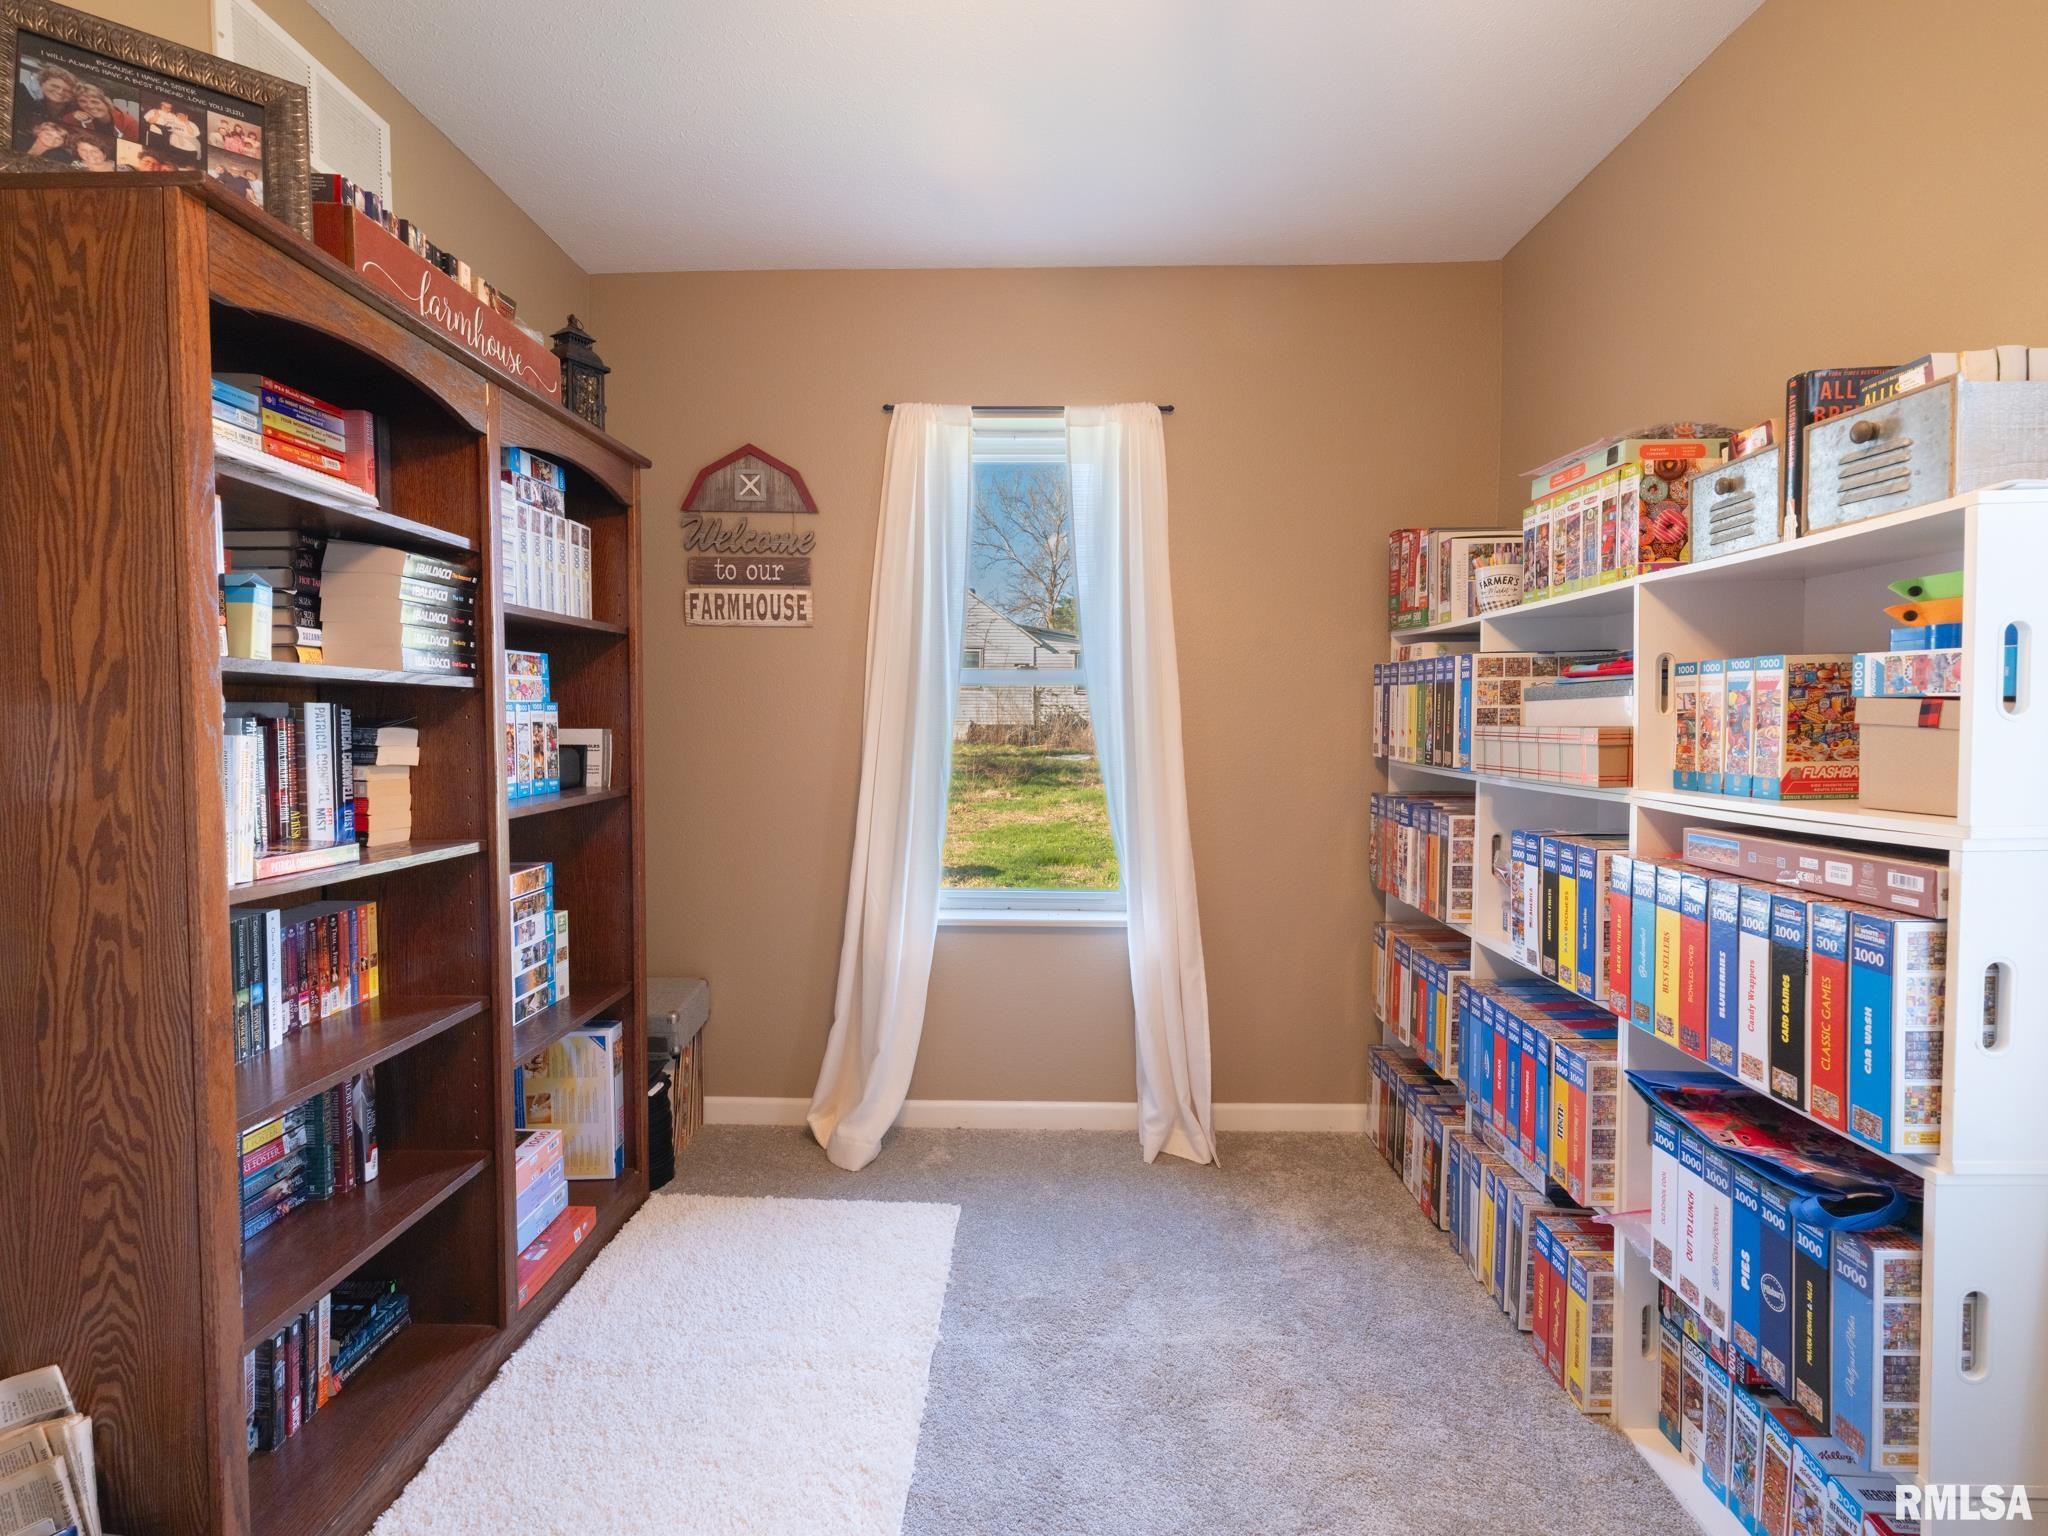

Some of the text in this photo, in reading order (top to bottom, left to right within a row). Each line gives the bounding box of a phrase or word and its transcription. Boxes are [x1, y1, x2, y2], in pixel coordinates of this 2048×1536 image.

[45, 51, 66, 63] WILL
[68, 59, 100, 73] ALWAYS
[101, 68, 123, 80] HAVE
[132, 77, 153, 89] BEST
[208, 101, 224, 112] YOU
[95, 59, 134, 76] BECAUSE
[141, 73, 161, 84] HAVE
[171, 82, 198, 95] SISTER
[1820, 379, 1857, 401] ALL
[681, 516, 816, 556] Welcome
[420, 563, 453, 580] BALDACCI
[714, 558, 784, 581] to our
[1479, 576, 1519, 590] FARMER'S
[414, 586, 448, 602] BALDACCI
[416, 609, 448, 625] BALDACCI
[689, 592, 807, 621] FARMHOUSE
[416, 633, 450, 647] BALDACCI
[416, 656, 451, 669] BALDACCI
[1678, 665, 1695, 674] 1000
[1703, 663, 1720, 672] 1000
[1731, 660, 1750, 670] 1000
[1760, 659, 1780, 668] 1000
[1854, 662, 1864, 690] 1000
[314, 706, 328, 751] PATRICIA
[340, 708, 354, 832] PATRICIA CORNWELL dust
[314, 808, 326, 832] MIST
[1580, 868, 1593, 879] 1000
[1613, 879, 1627, 891] 1000
[1635, 885, 1652, 898] 1000
[1658, 893, 1676, 906] 1000
[1684, 901, 1701, 915] 500
[1712, 908, 1733, 923] 1000
[1742, 916, 1765, 932] 1000
[253, 920, 261, 956] Captivated
[1774, 924, 1800, 942] 1000
[1854, 932, 1886, 945] MOUNTAIN
[1861, 927, 1879, 938] WHITE
[1816, 935, 1837, 953] 500
[1662, 930, 1671, 994] BEST SELLERS
[1854, 946, 1884, 967] 1000
[1748, 959, 1756, 1001] Wrappers
[1781, 1015, 1791, 1044] CARD
[1820, 976, 1831, 1071] CLASSIC GAMES
[1864, 1007, 1873, 1075] CAR WASH
[1655, 1131, 1675, 1151] 1000
[252, 1148, 281, 1169] FOSTER
[1682, 1151, 1701, 1172] 1000
[1706, 1167, 1729, 1190] 1000
[1735, 1188, 1758, 1212] 1000
[1762, 1206, 1786, 1231] 1000
[1686, 1224, 1694, 1239] TO
[1537, 1238, 1549, 1257] 1000
[1685, 1239, 1694, 1262] OUT
[1797, 1231, 1823, 1259] 1000
[1552, 1255, 1564, 1275] 1000
[1741, 1250, 1750, 1291] PIES
[1837, 1258, 1867, 1289] 1000
[1572, 1276, 1586, 1297] 1000
[1663, 1319, 1678, 1337] 1000
[1684, 1338, 1705, 1362] 1000
[1728, 1343, 1737, 1376] 1000
[1708, 1362, 1726, 1383] 1000
[1738, 1389, 1757, 1413] 1000
[1769, 1417, 1789, 1443] 1000
[1829, 1501, 1859, 1535] HERSHEY'S
